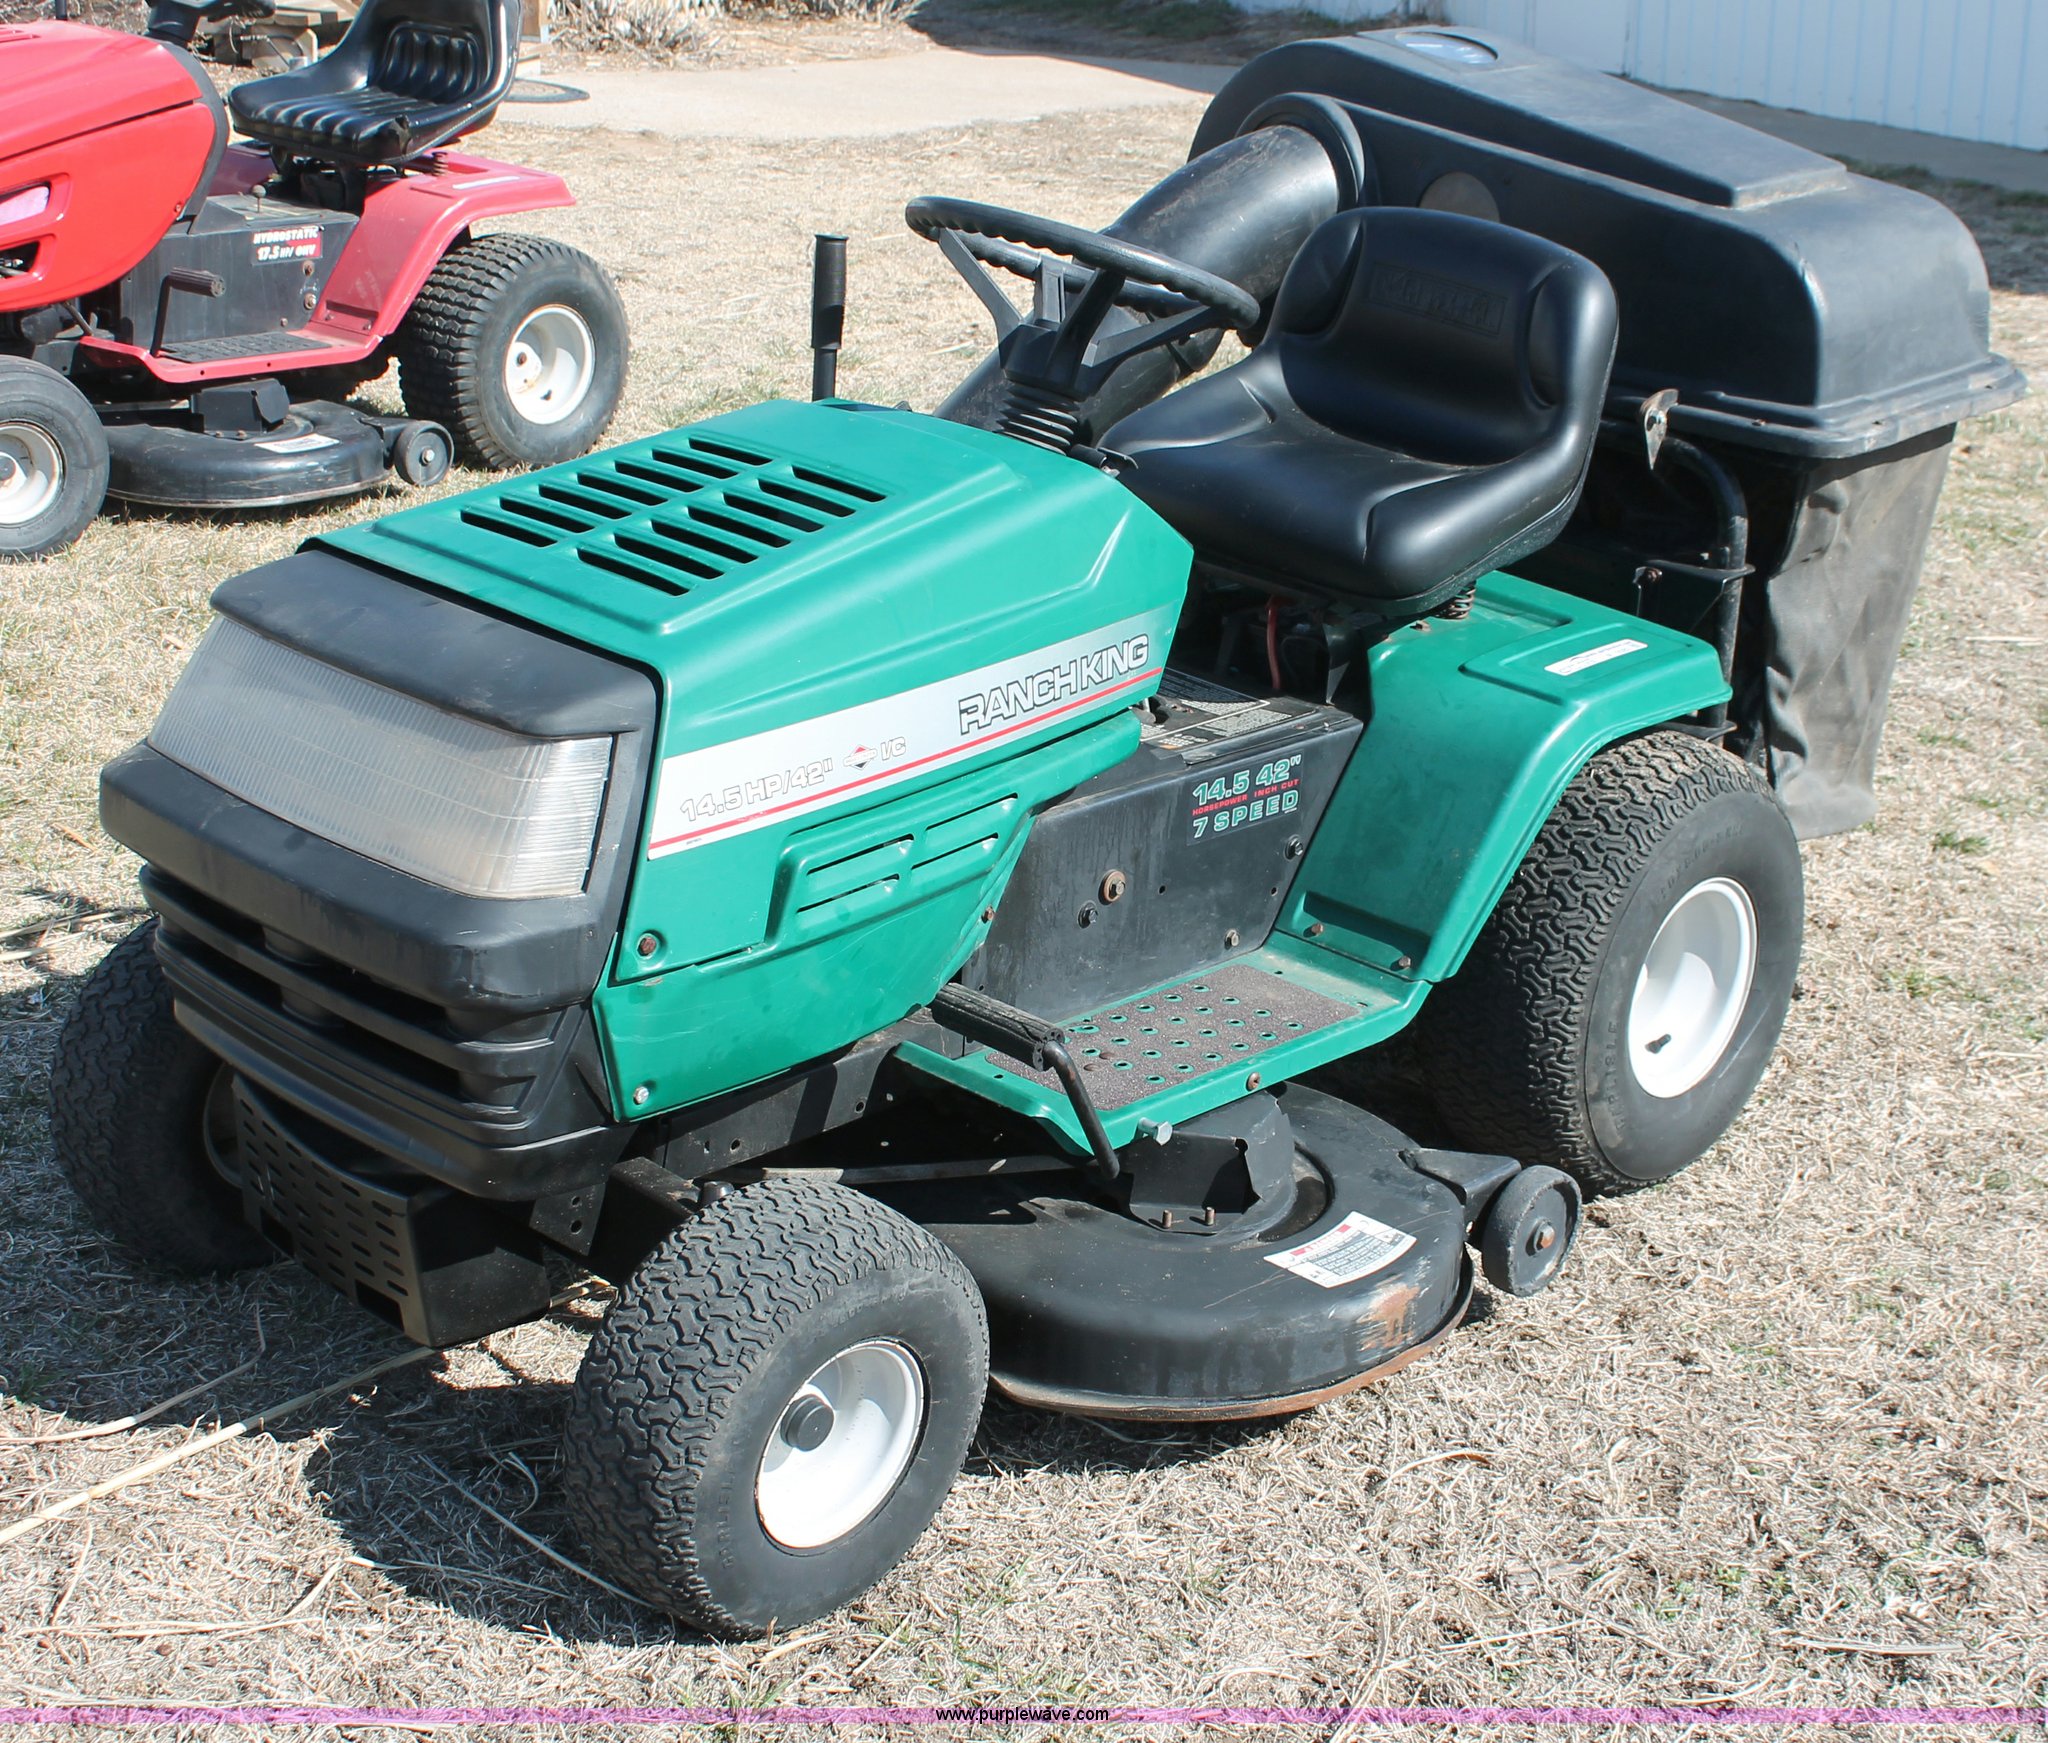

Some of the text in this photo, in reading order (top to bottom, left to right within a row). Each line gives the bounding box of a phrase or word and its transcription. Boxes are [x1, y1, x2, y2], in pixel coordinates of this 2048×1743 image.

[253, 225, 319, 244] HYDROSTATIC
[257, 245, 279, 260] 17.5
[1081, 633, 1149, 691] KING
[1192, 778, 1300, 816] HORSEPOWER INCH CUT
[1193, 754, 1302, 806] 14.5 42"
[680, 785, 743, 822] 14.5
[1193, 790, 1299, 839] 7 SPEED
